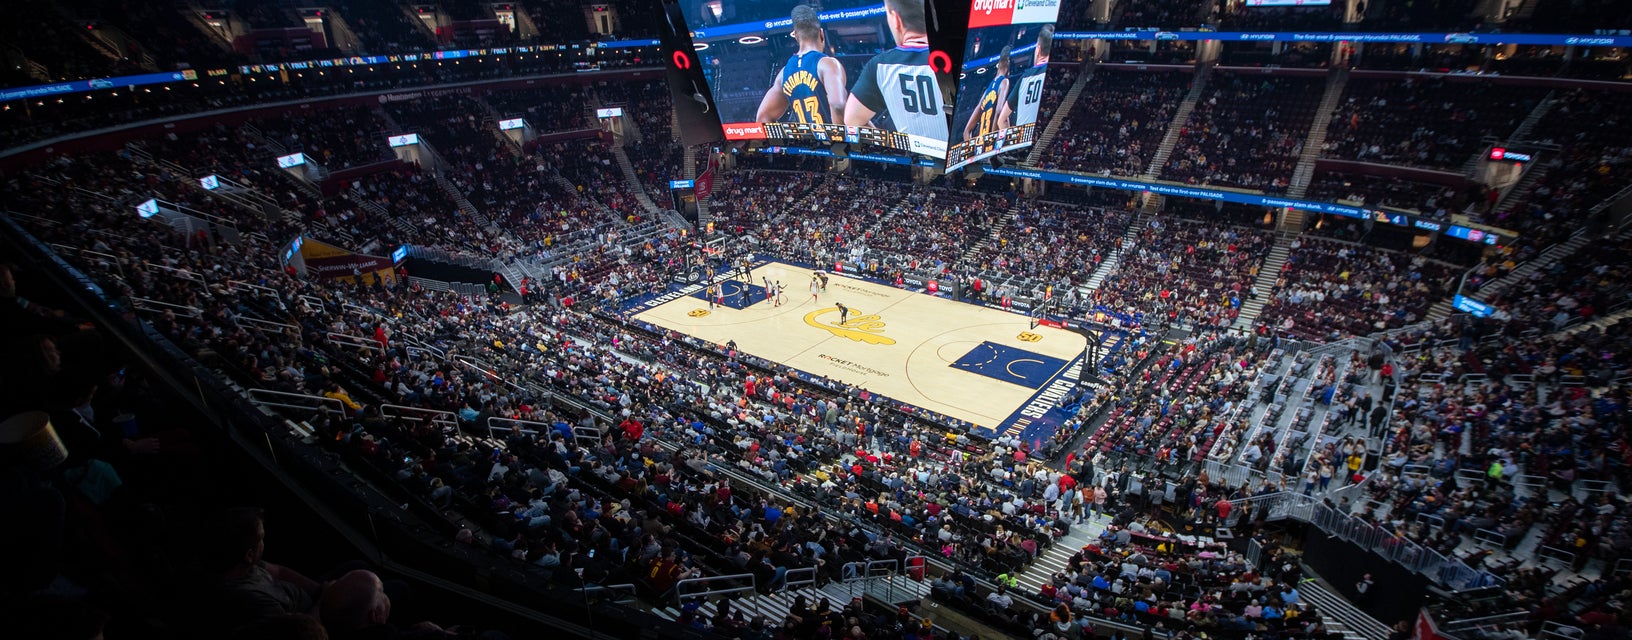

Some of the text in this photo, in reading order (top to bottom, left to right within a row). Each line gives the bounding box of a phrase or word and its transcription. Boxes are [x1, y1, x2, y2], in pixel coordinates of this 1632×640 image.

[783, 70, 819, 97] THOMPSON
[899, 74, 938, 116] 50
[1025, 79, 1042, 106] 50
[793, 96, 826, 124] 13
[726, 127, 745, 136] drug
[744, 126, 763, 135] mart
[318, 260, 377, 271] SHERWIN-WILIAMS
[842, 264, 858, 273] TOYOTA
[644, 284, 704, 307] CLEVELAND
[938, 283, 953, 292] TOYO
[1011, 300, 1031, 309] TOYOTA
[1017, 331, 1043, 343] 50
[818, 353, 890, 377] ROCKET Mortgage
[1020, 379, 1076, 419] CAVALIERS
